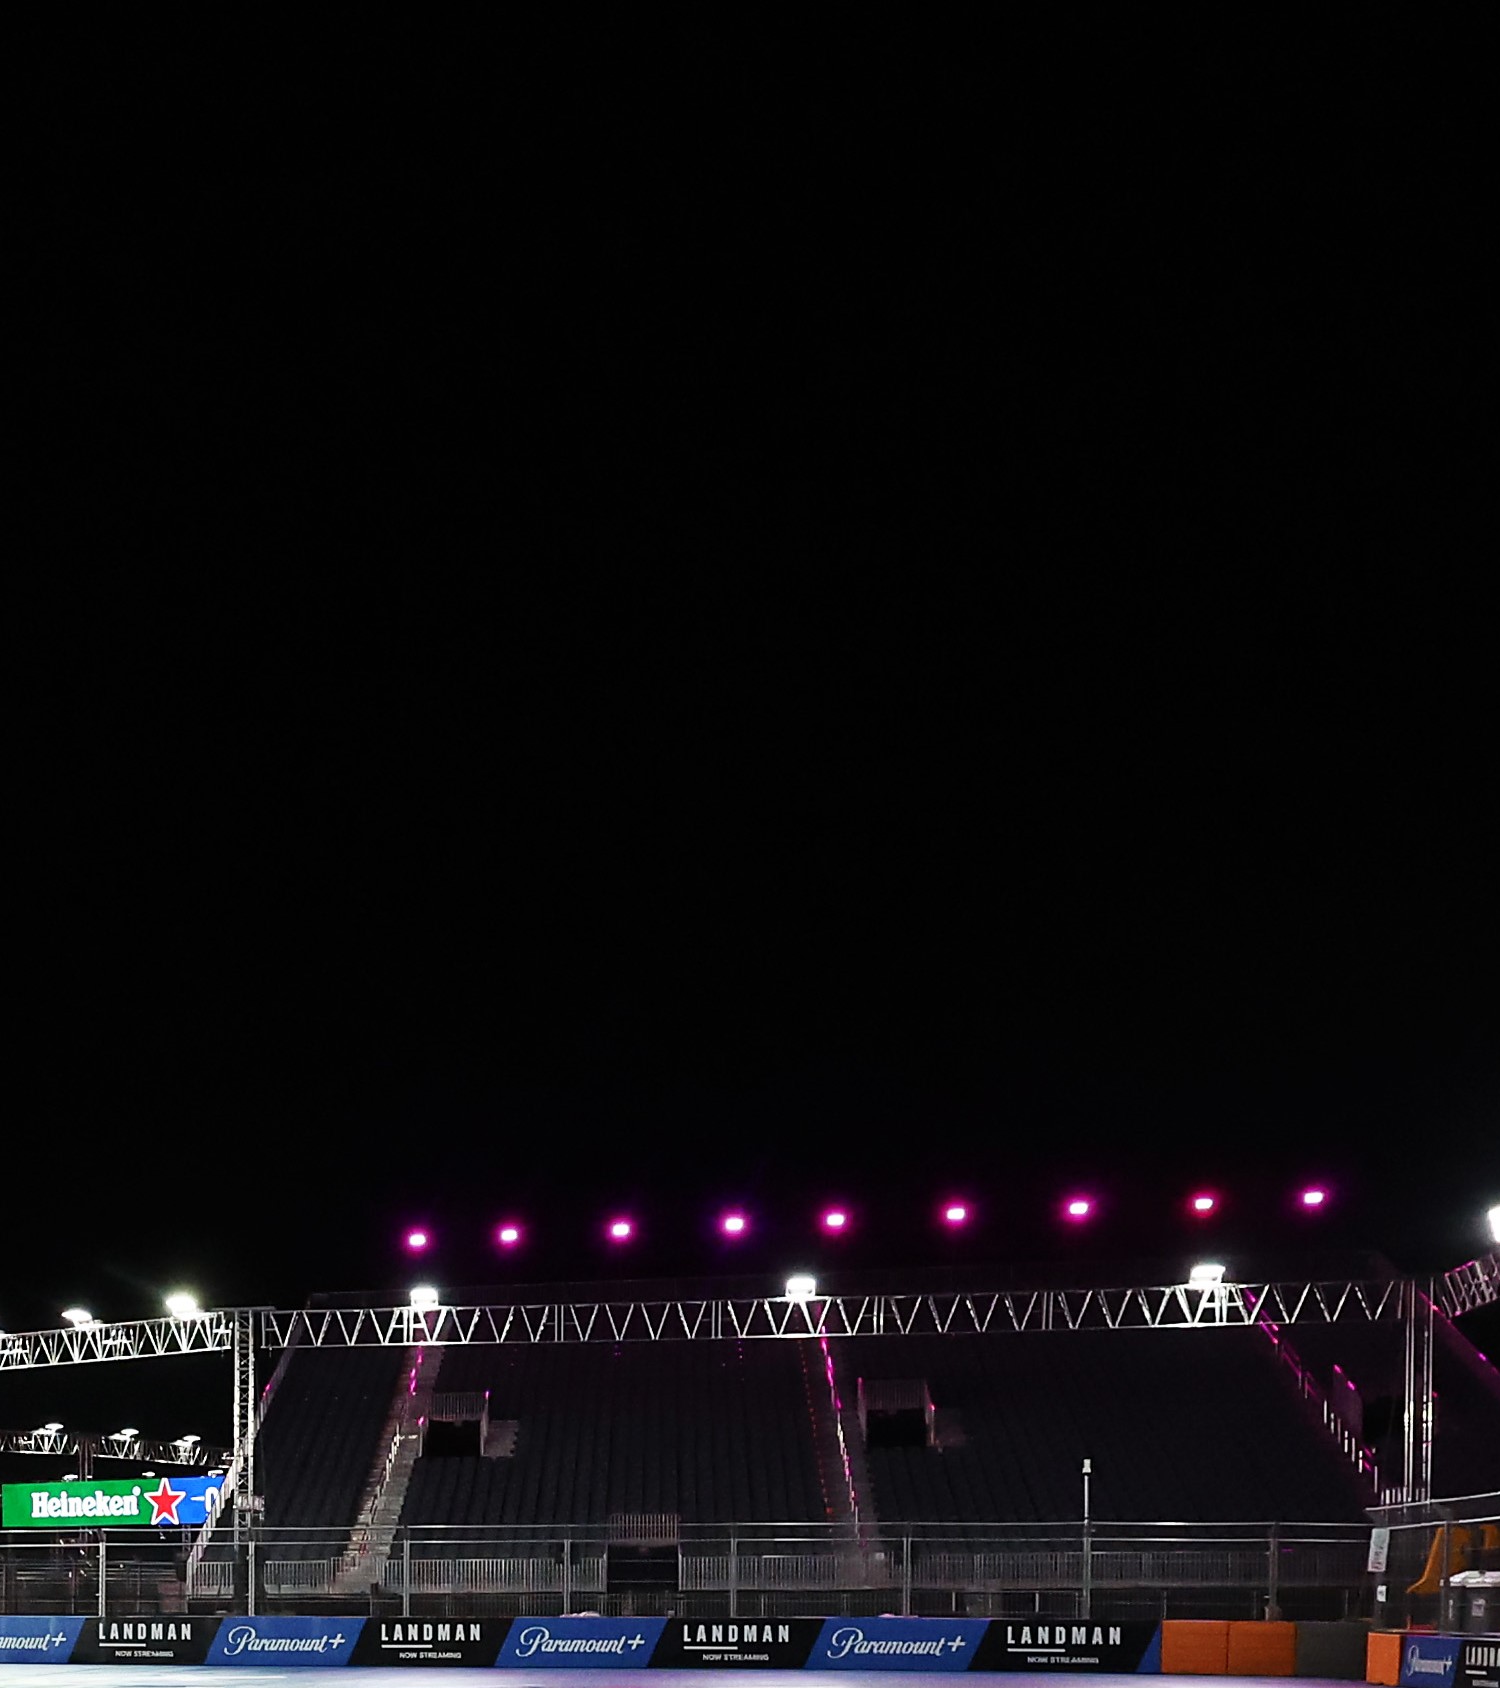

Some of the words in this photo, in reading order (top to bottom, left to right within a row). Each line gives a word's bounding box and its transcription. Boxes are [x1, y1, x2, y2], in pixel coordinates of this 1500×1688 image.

[31, 1490, 139, 1518] Heineken
[98, 1622, 192, 1641] LANDMAN
[223, 1625, 346, 1656] Paramount+
[381, 1623, 481, 1642] LANDMAN
[515, 1626, 646, 1657] Paramount+
[683, 1624, 790, 1643] LANDMAN
[826, 1627, 966, 1659] Paramount+
[1007, 1625, 1121, 1646] LANDMAN
